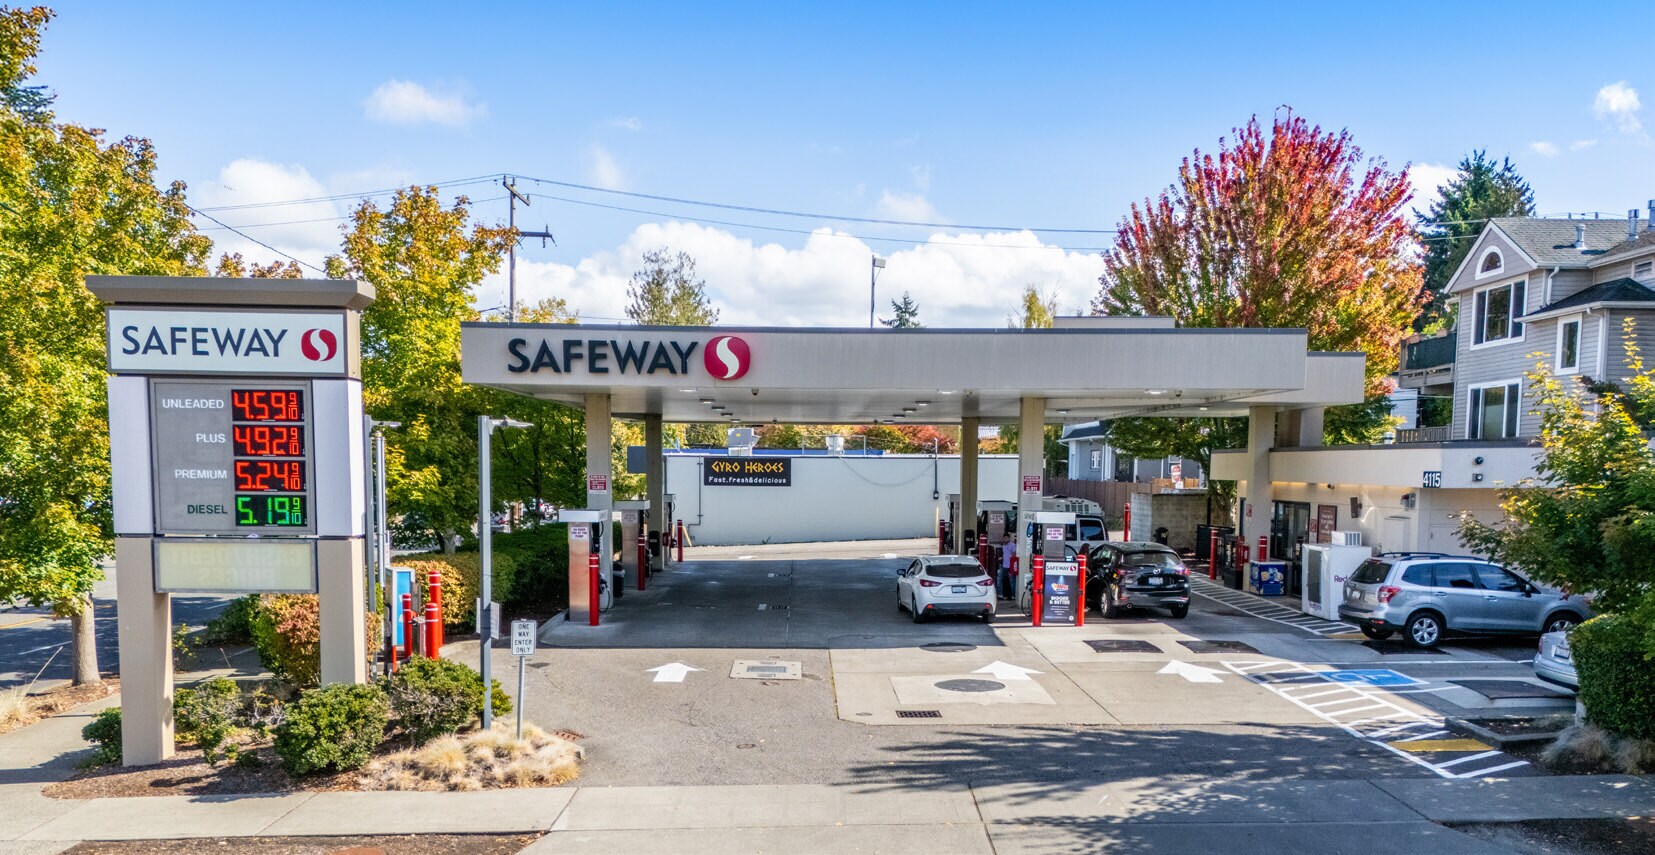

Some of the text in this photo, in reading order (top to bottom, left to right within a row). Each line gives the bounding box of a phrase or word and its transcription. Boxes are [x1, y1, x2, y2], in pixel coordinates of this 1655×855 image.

[121, 325, 288, 358] SAFEWAY
[507, 338, 699, 375] SAFEWAY
[162, 398, 225, 410] UNLEADED
[233, 391, 287, 420] 4.59
[196, 433, 226, 444] PLUS
[234, 426, 287, 455] 4.92
[175, 469, 228, 480] PREMIUM
[236, 461, 289, 490] 5.24
[711, 460, 784, 474] GYRO HEROES
[1423, 472, 1441, 488] 4115
[187, 503, 228, 515] DIESEL
[237, 496, 290, 525] 5.19
